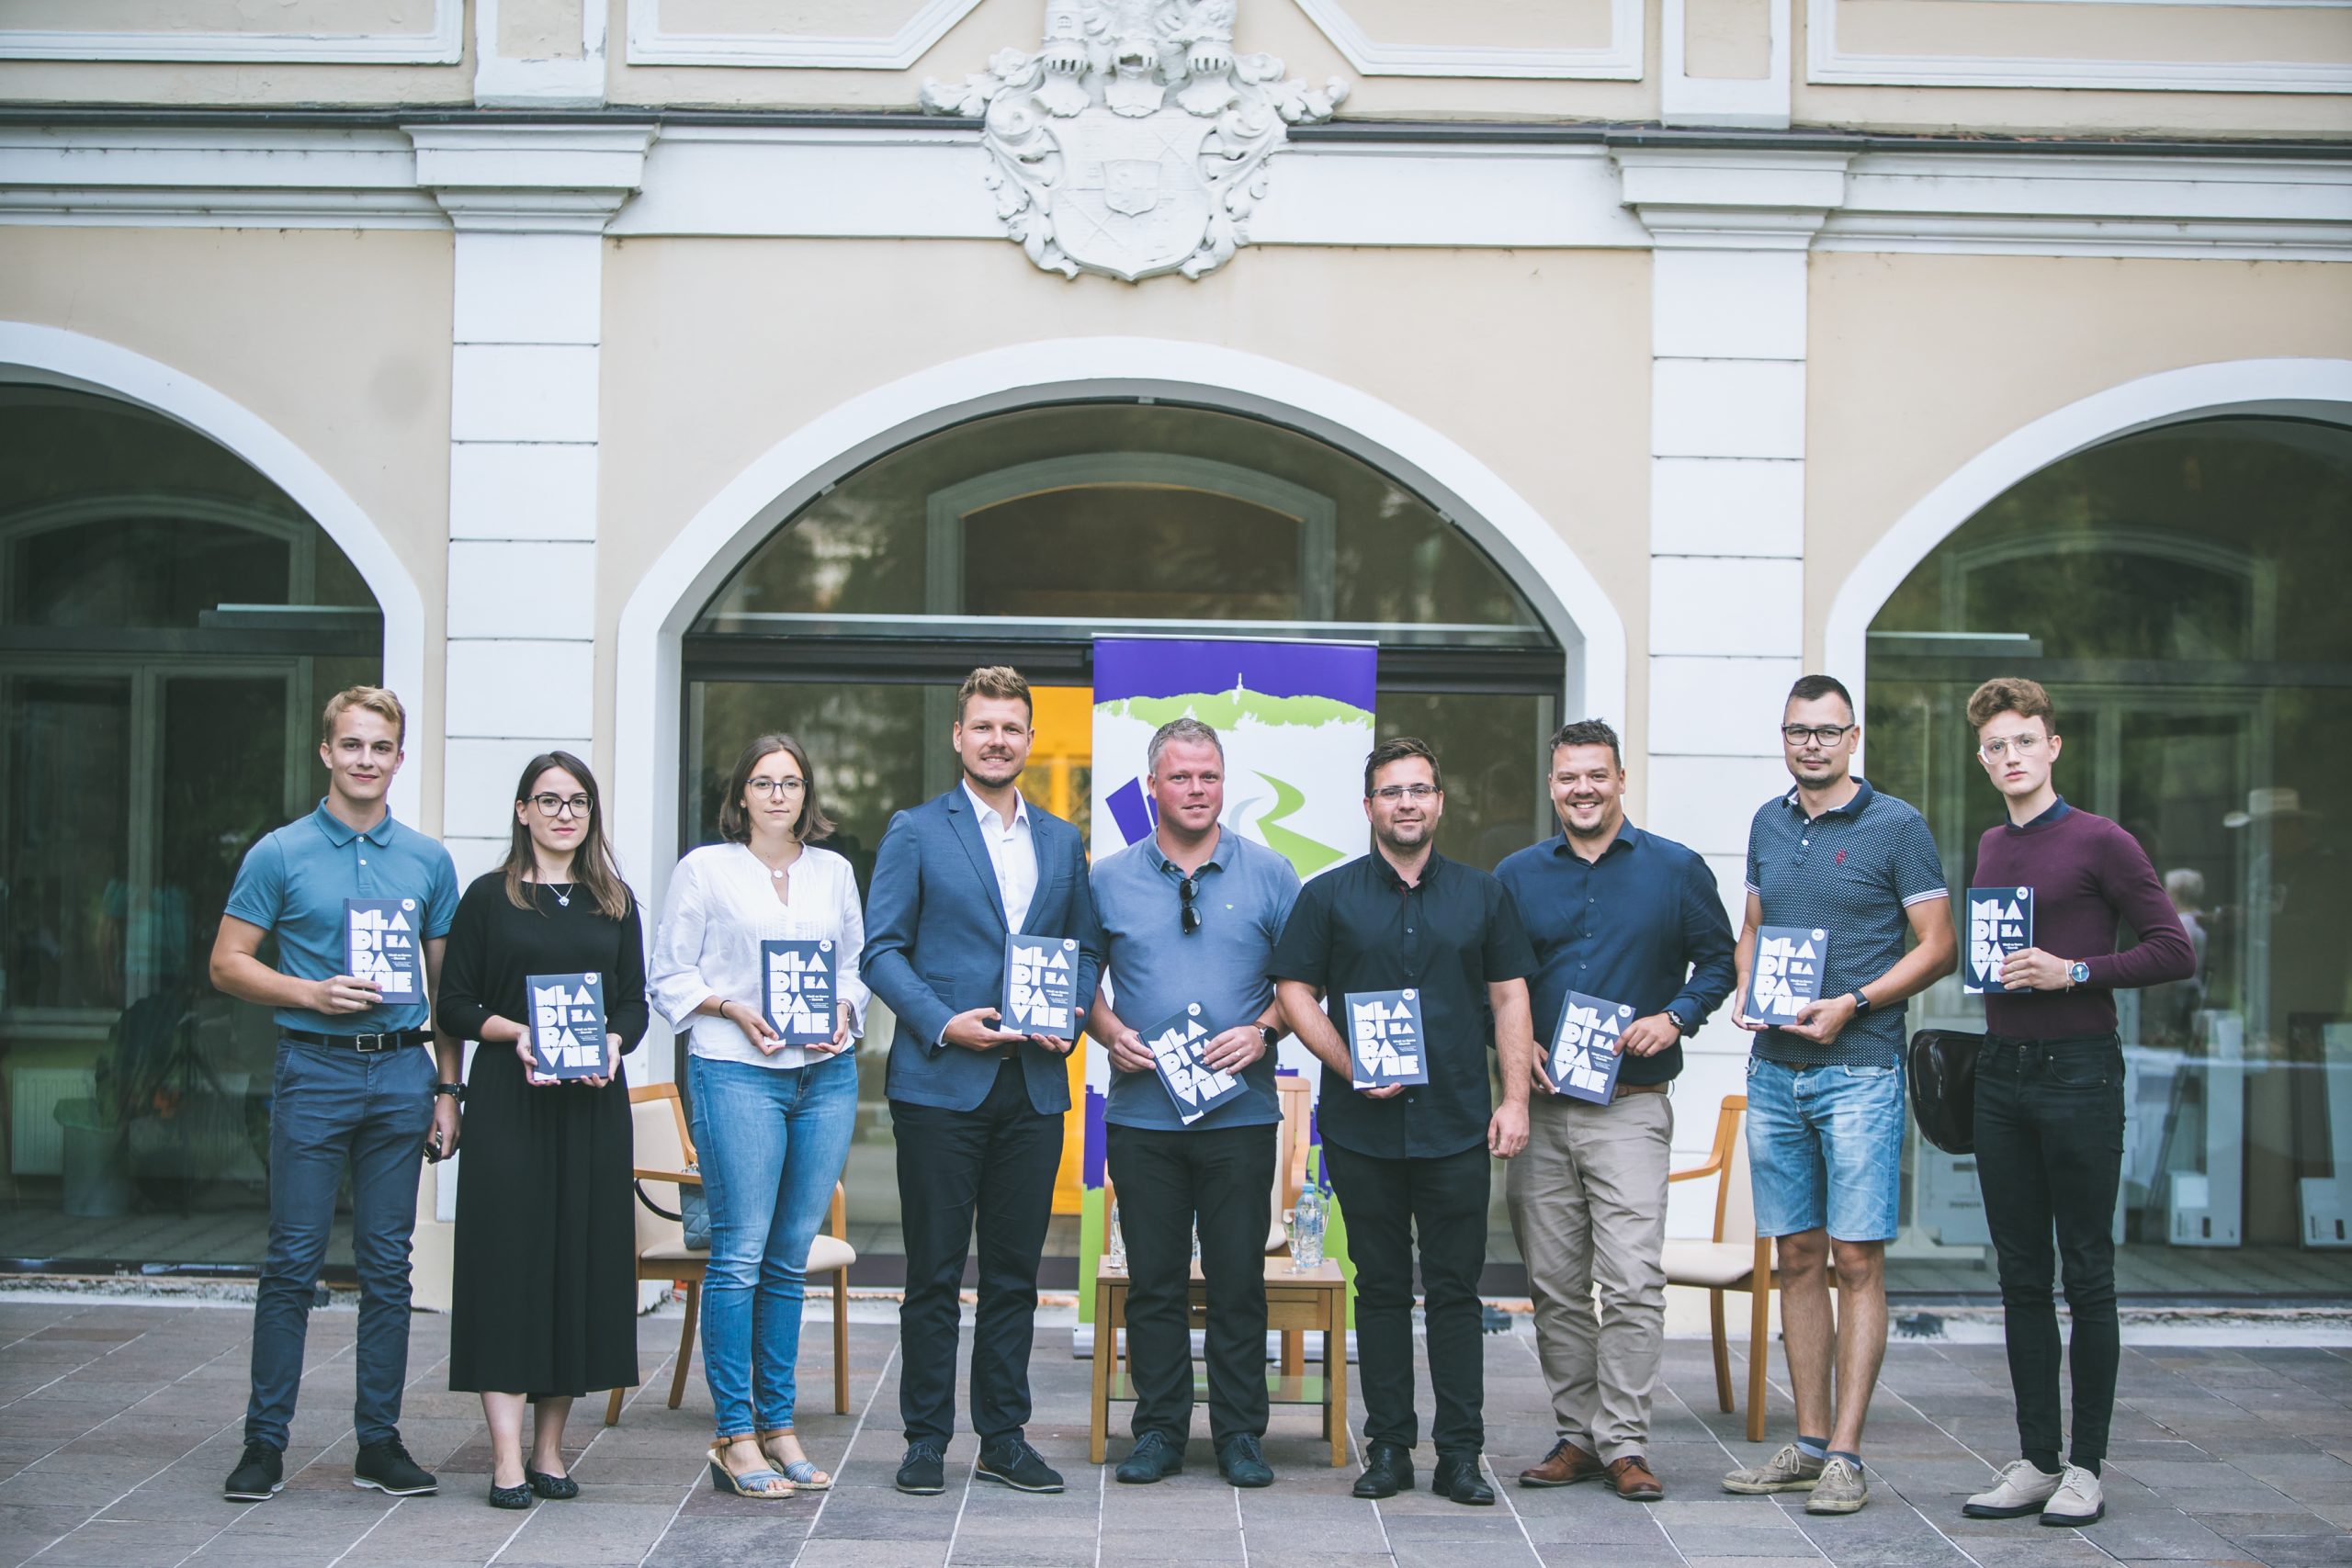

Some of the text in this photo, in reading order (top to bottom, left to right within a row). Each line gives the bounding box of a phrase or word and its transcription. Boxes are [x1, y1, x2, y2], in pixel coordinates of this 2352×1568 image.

[351, 909, 412, 931] MLA
[1972, 899, 2024, 919] MLA
[1012, 944, 1069, 969] MLA
[1760, 936, 1816, 959] MLA
[769, 951, 828, 972] MLA
[535, 984, 595, 1007] MLA
[1352, 999, 1413, 1021] MLA
